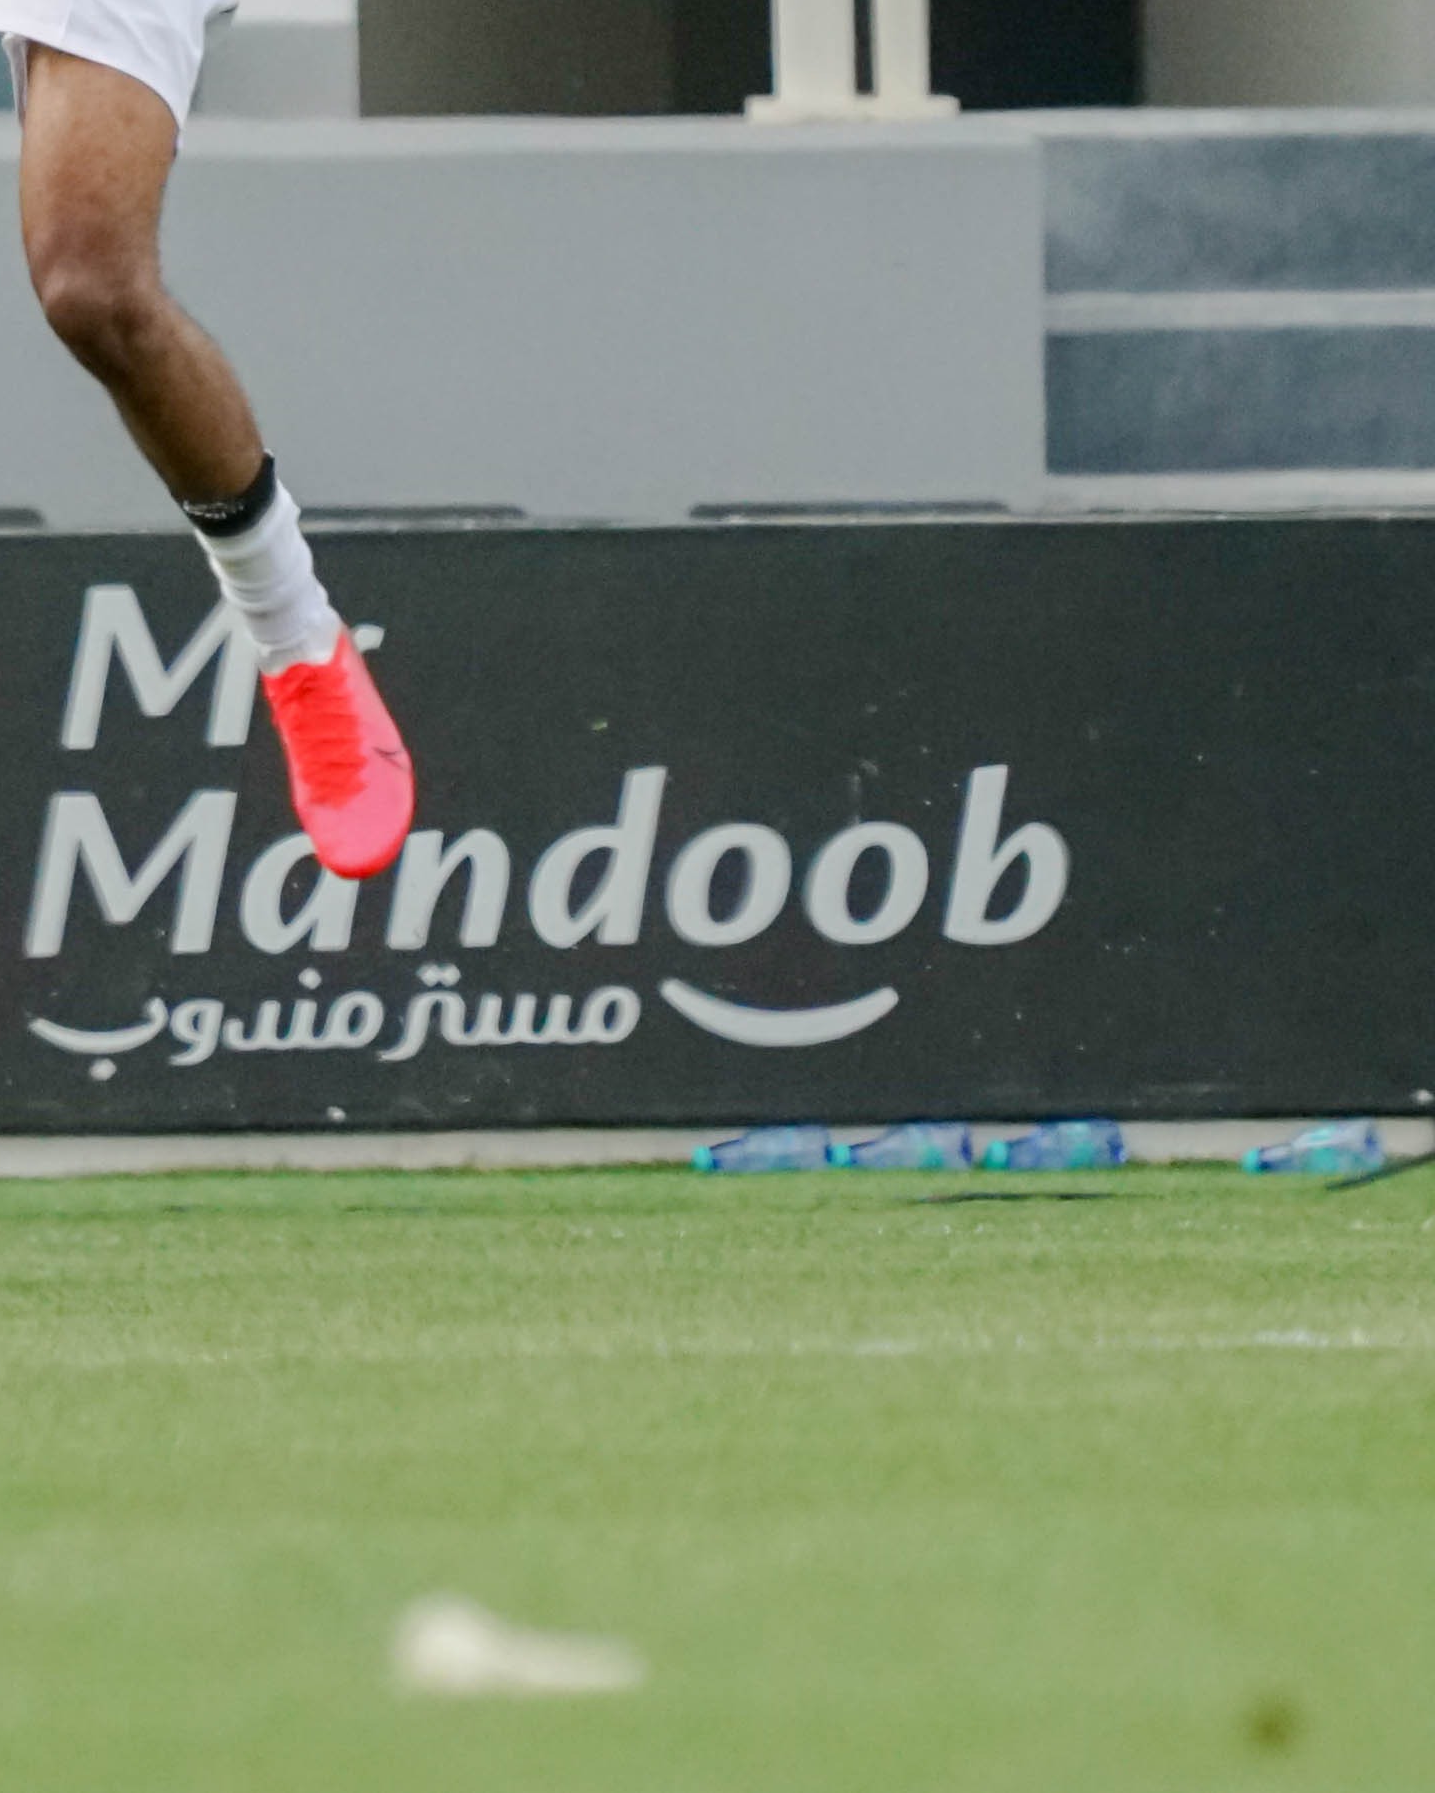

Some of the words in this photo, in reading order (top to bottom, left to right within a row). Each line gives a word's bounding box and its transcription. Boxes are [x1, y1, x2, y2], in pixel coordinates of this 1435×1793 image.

[60, 583, 385, 751] M
[25, 763, 1069, 958] Mandoob
[29, 968, 385, 1081] مندوب
[379, 964, 642, 1061] مستر
